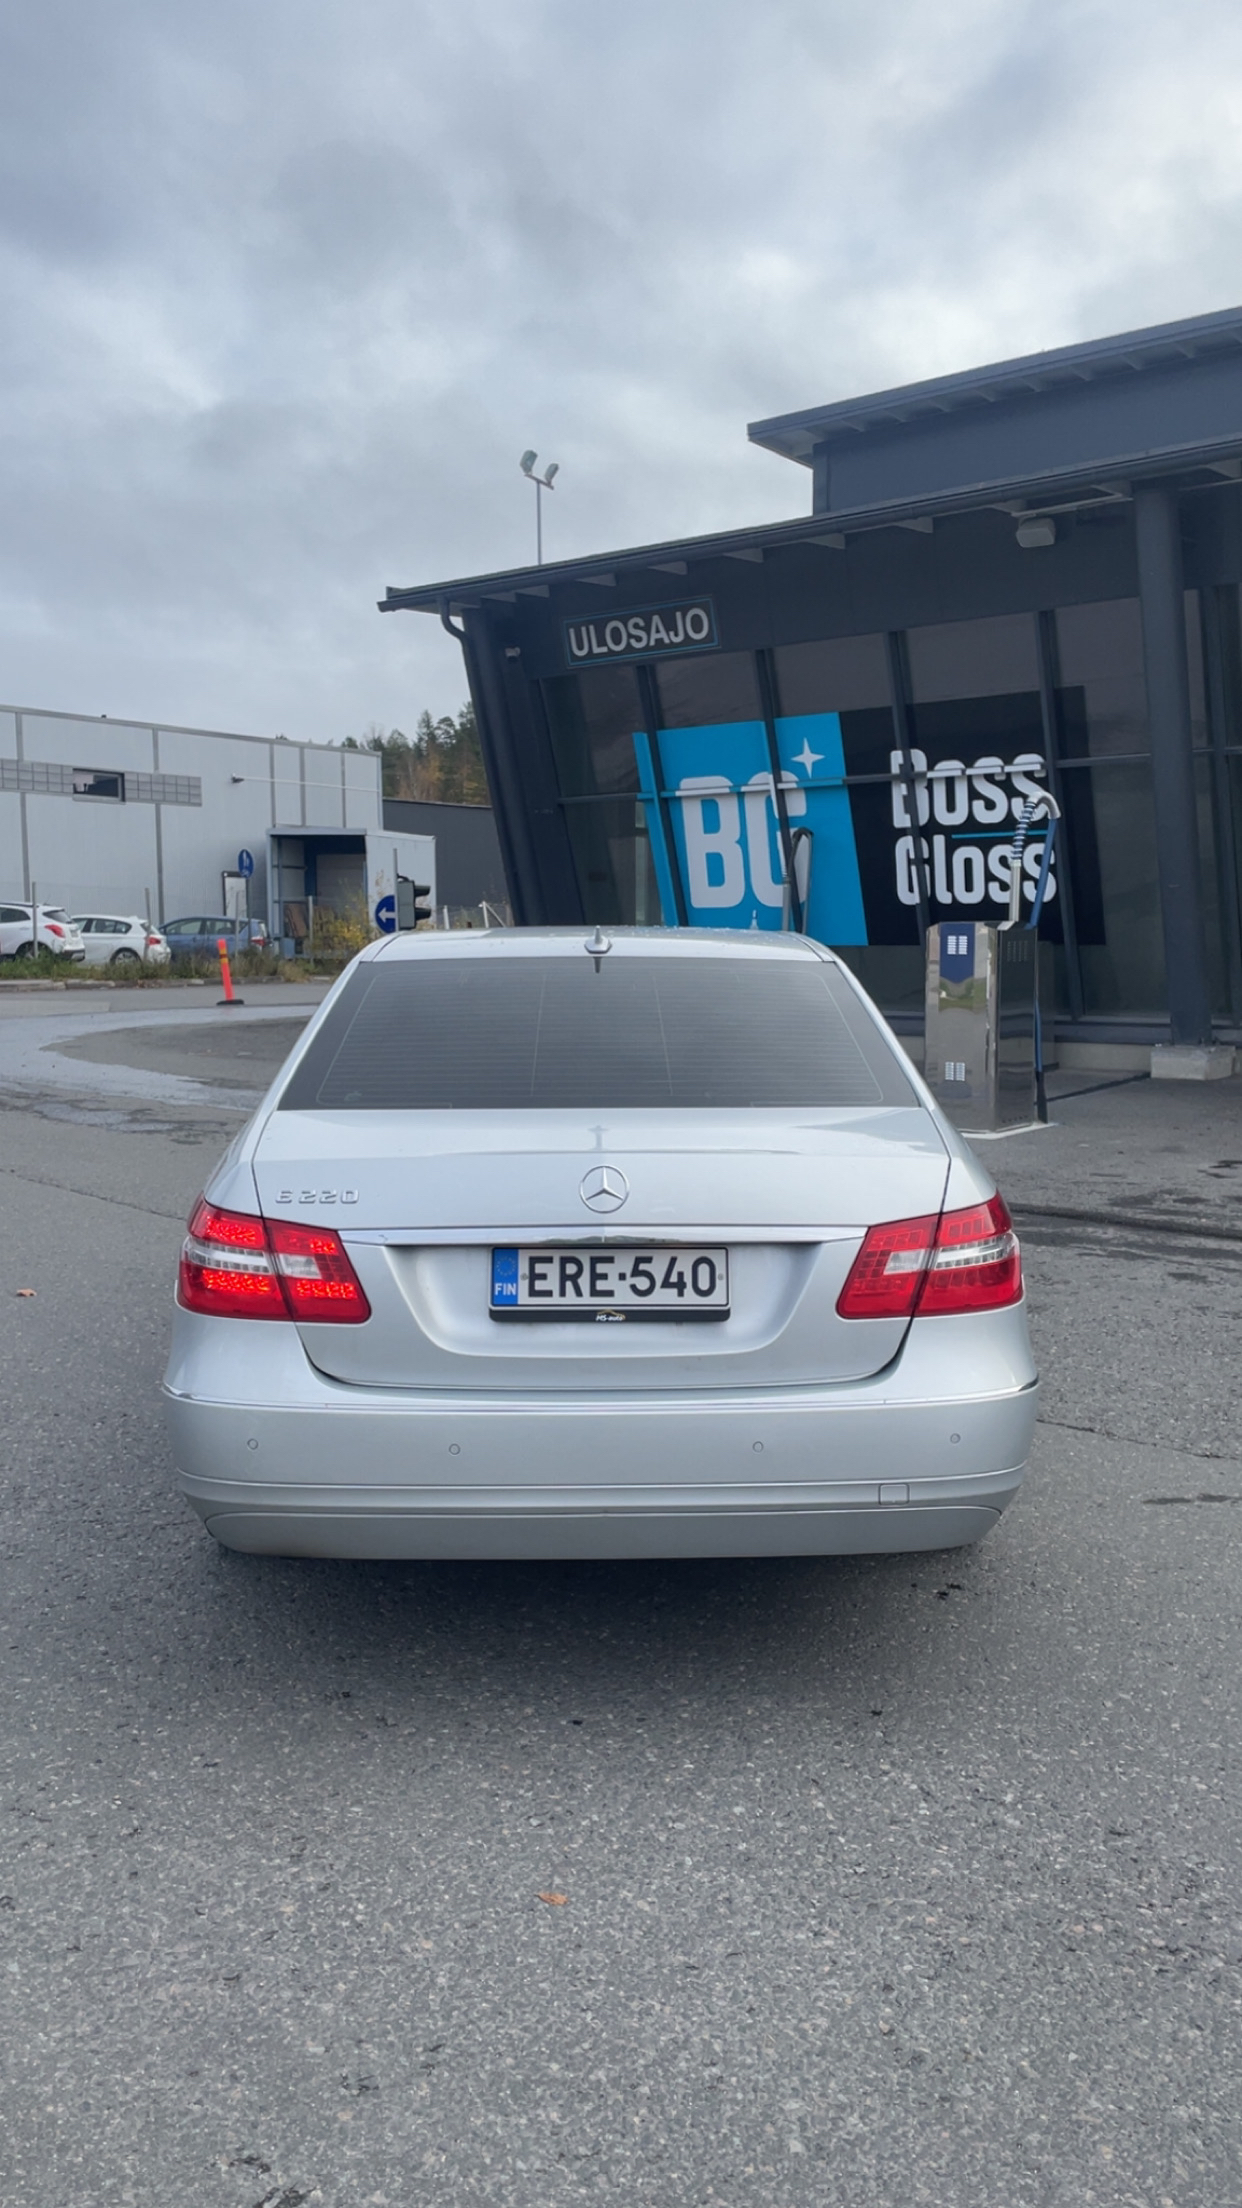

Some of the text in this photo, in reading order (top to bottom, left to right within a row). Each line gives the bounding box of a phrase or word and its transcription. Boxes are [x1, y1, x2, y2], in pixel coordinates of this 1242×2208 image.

[568, 607, 709, 657] ULOSAJO
[890, 748, 1047, 828] Boss
[677, 771, 811, 908] BG
[895, 834, 1057, 906] Gloss
[494, 1255, 717, 1298] FIN ERE-540
